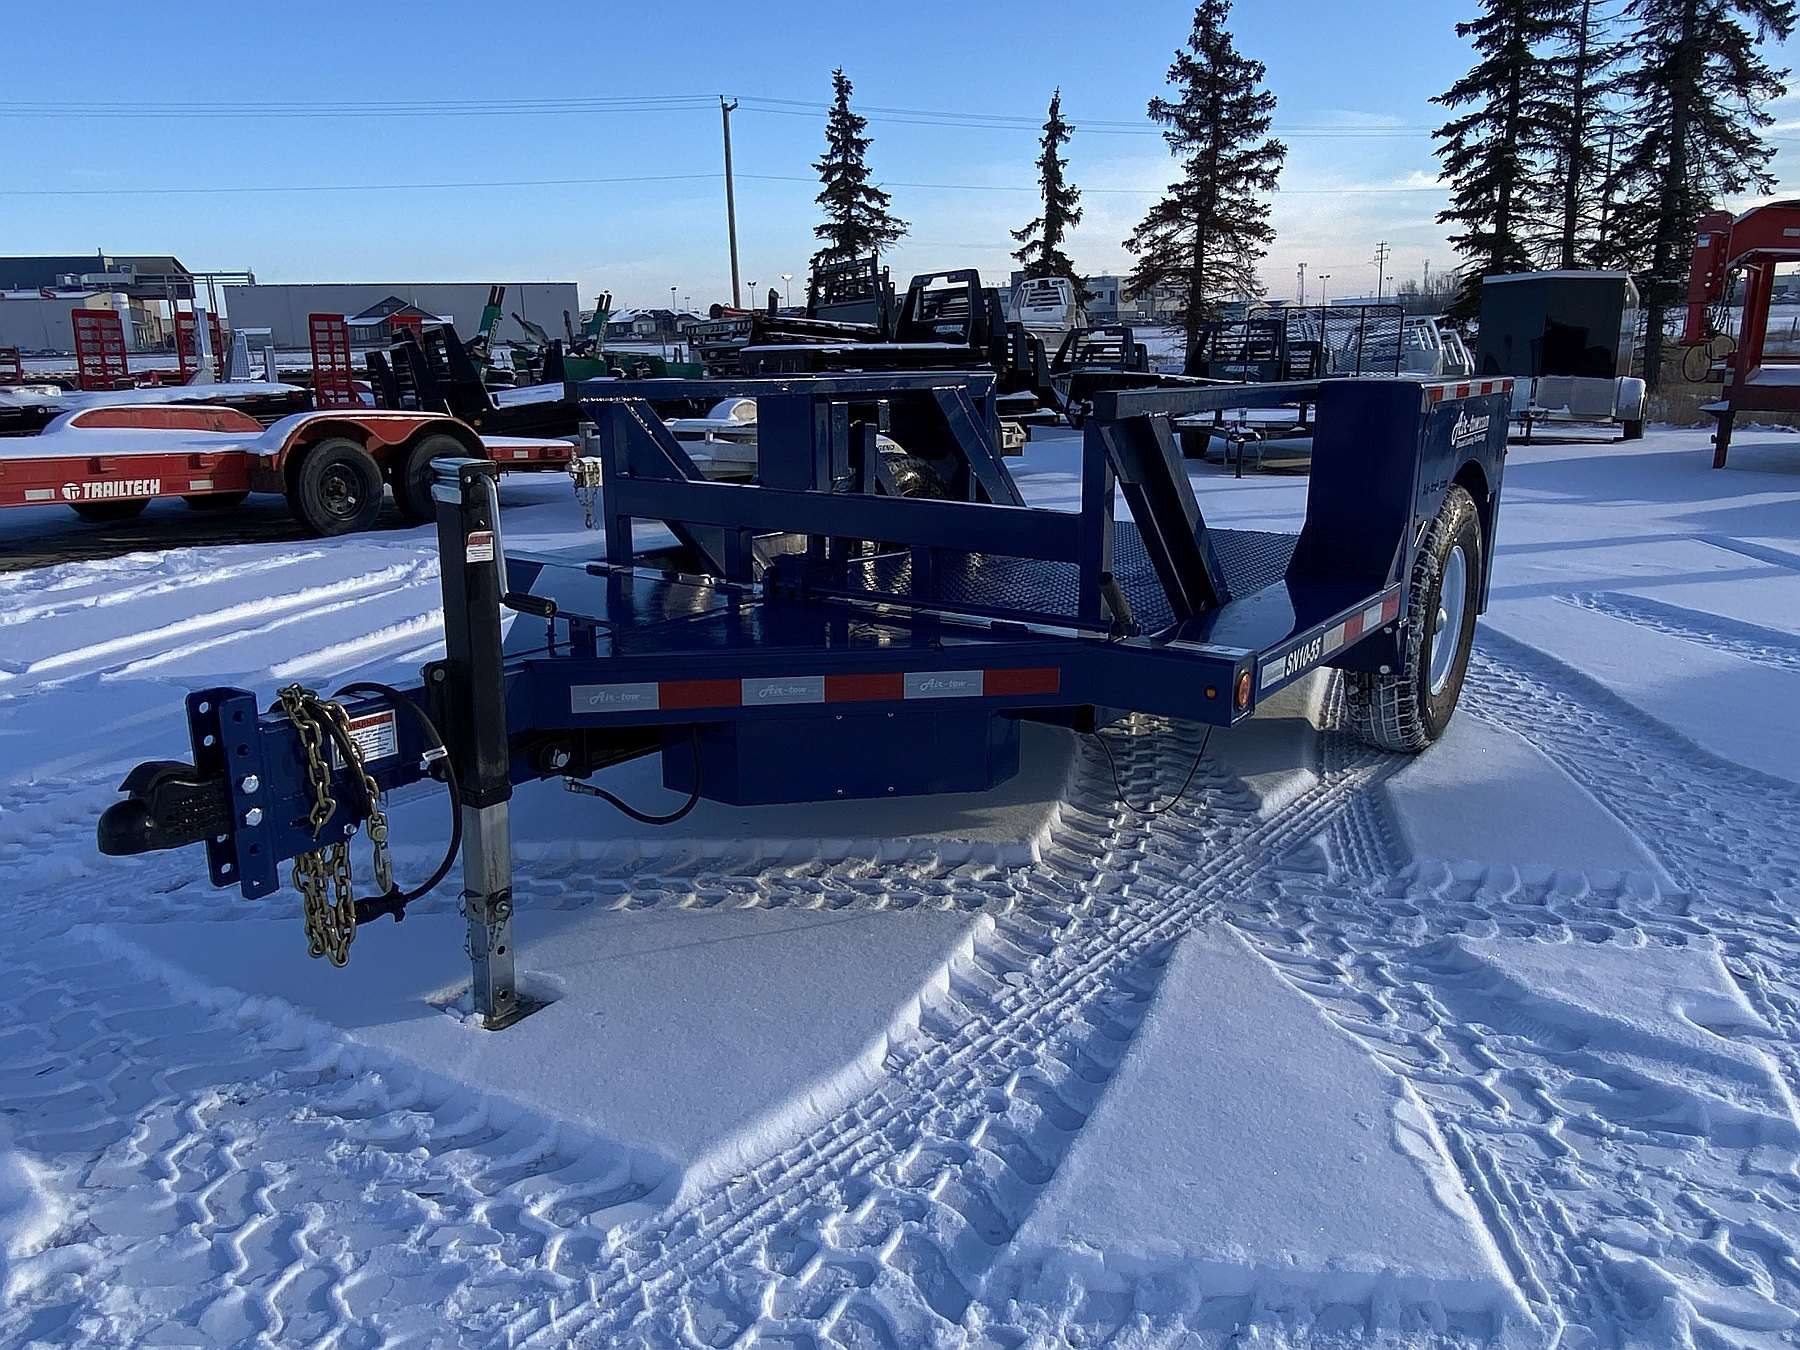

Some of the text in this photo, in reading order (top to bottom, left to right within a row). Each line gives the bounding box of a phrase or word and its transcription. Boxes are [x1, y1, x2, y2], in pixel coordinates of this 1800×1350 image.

[82, 479, 160, 498] TRAILTECH
[759, 684, 807, 698] Air-tow
[920, 678, 968, 691] Air-tow
[589, 690, 641, 705] Air-tow
